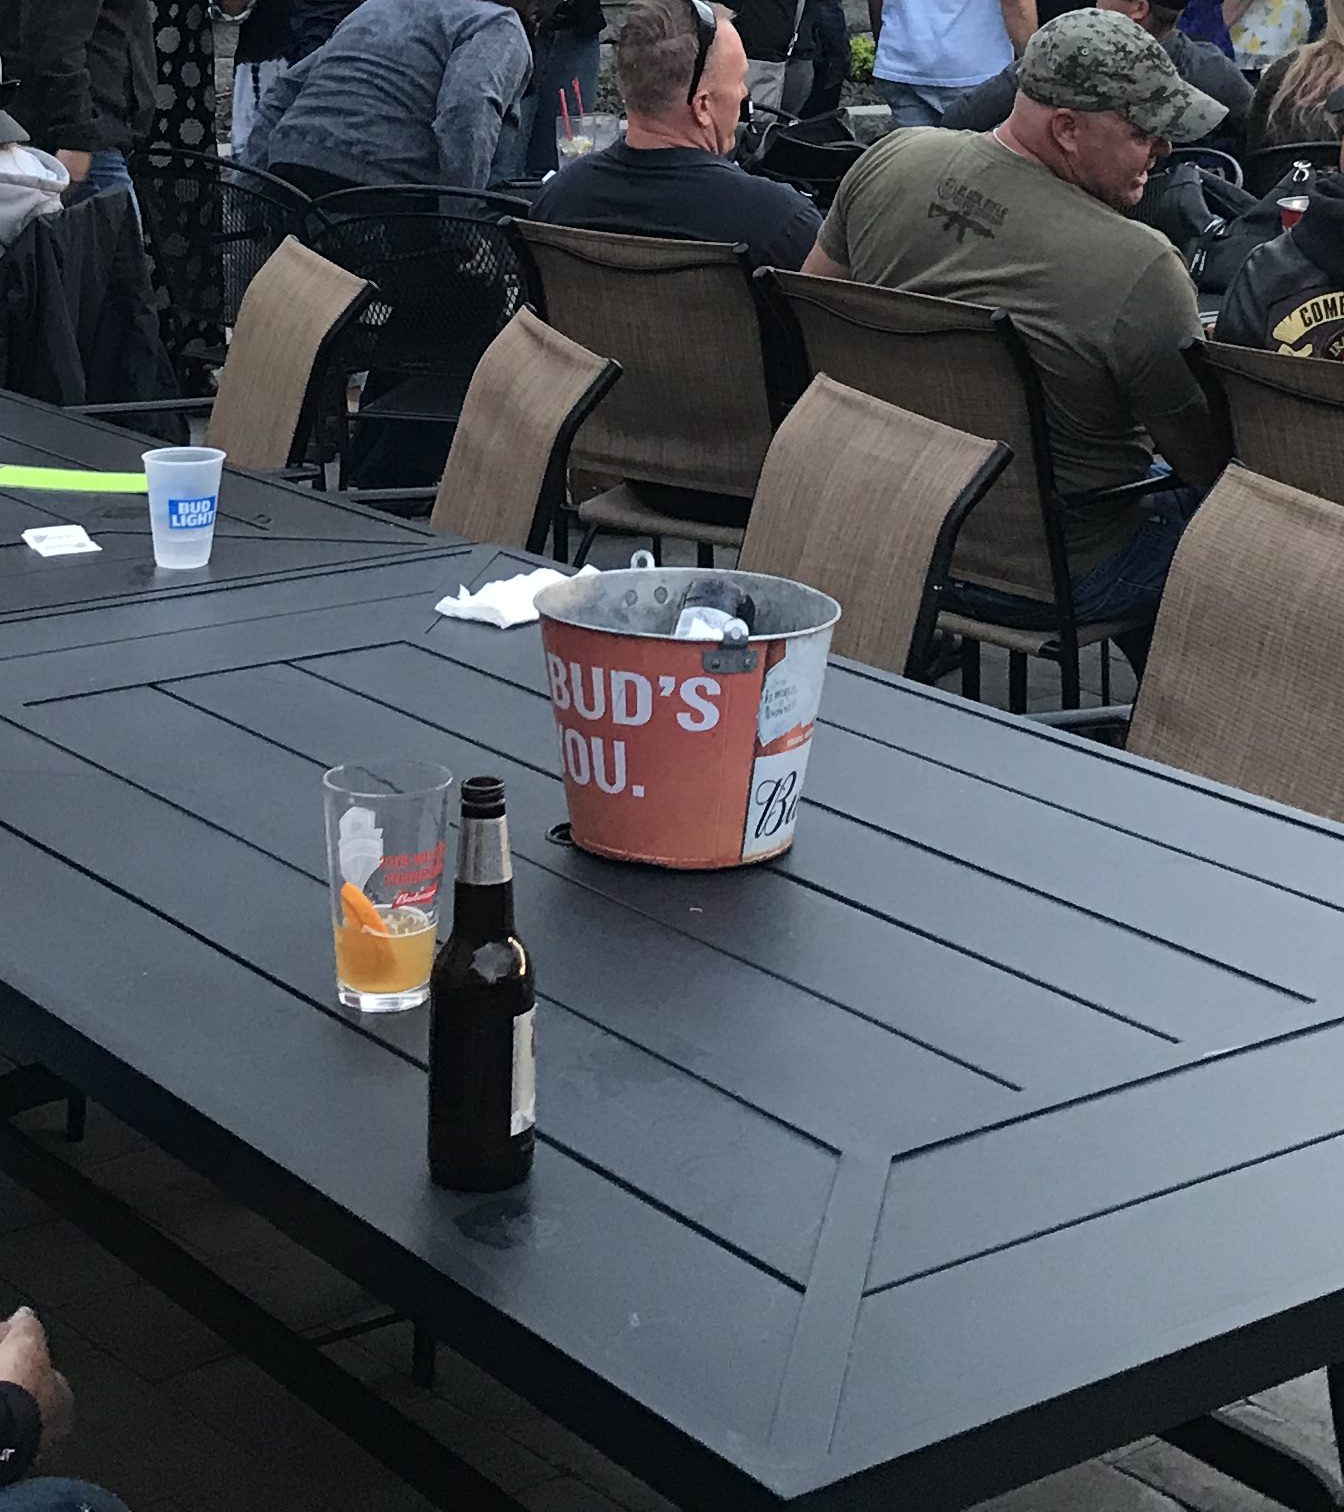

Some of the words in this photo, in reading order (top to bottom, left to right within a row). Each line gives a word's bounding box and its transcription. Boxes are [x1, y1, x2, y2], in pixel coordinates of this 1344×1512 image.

[177, 500, 211, 514] BUD
[171, 510, 214, 528] LIGHT
[547, 652, 722, 732] BUD'S
